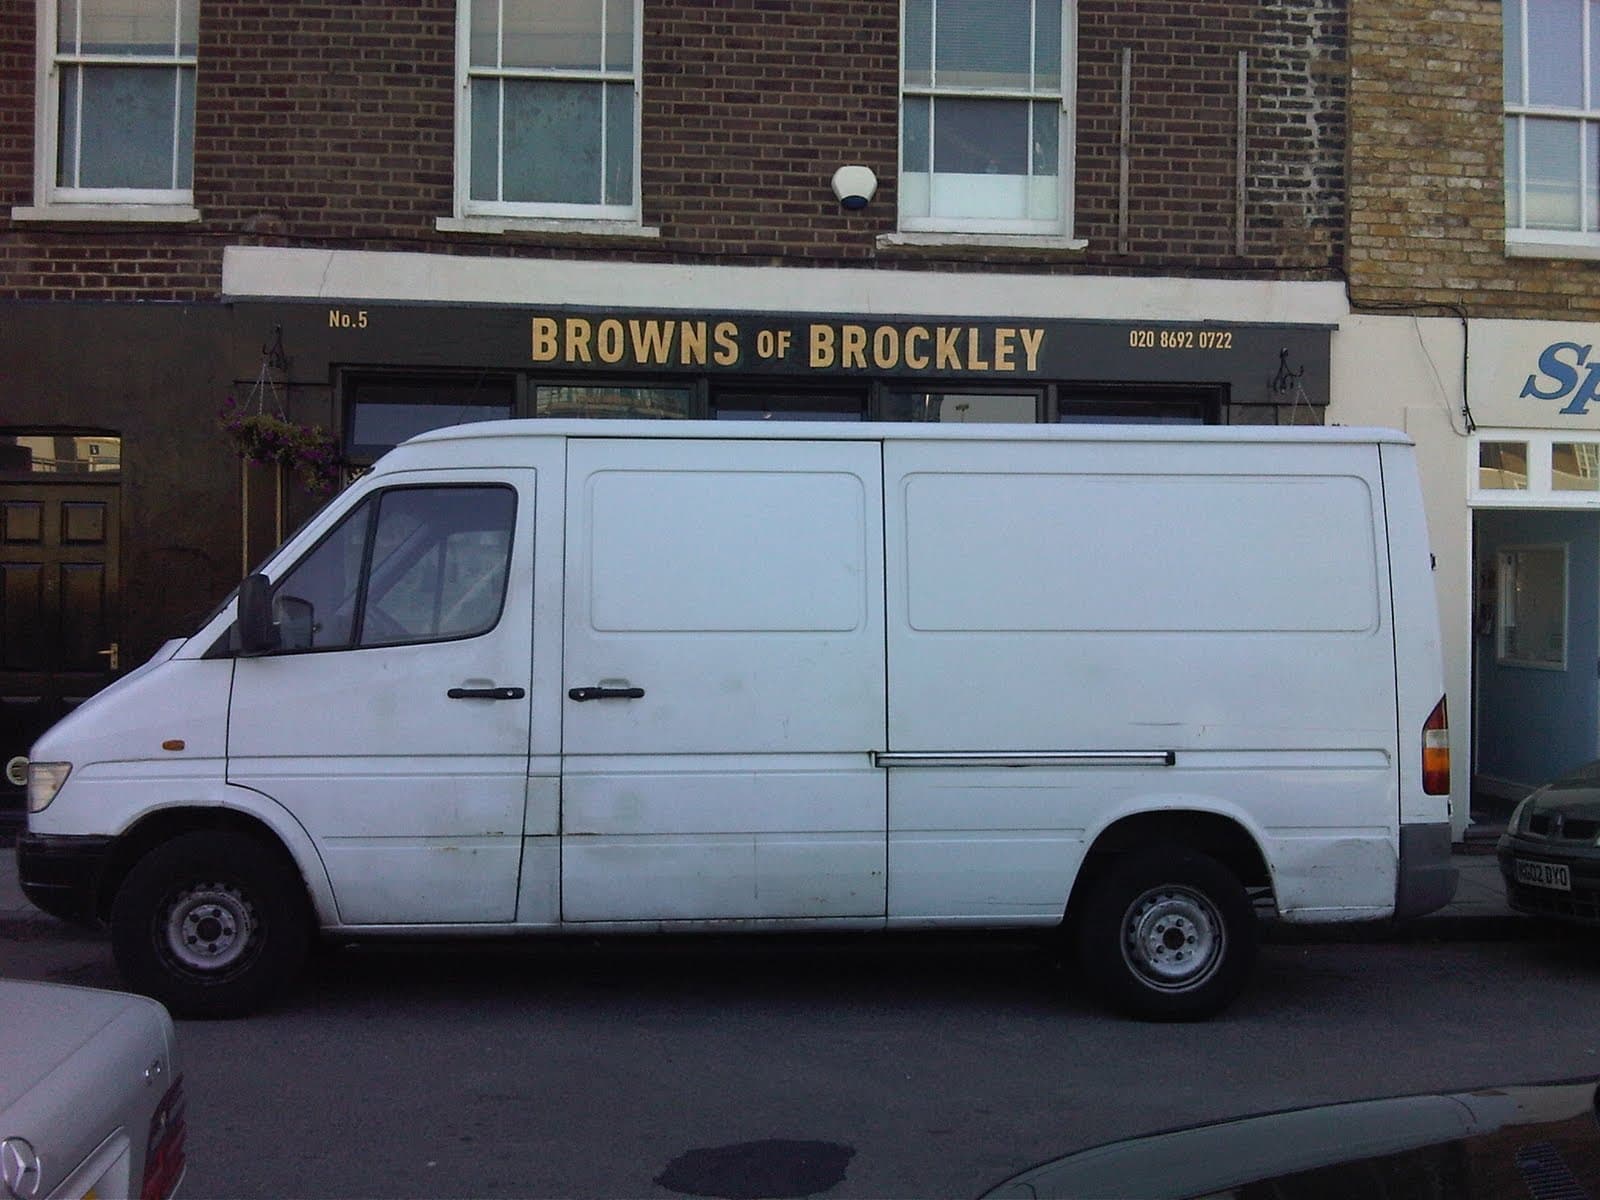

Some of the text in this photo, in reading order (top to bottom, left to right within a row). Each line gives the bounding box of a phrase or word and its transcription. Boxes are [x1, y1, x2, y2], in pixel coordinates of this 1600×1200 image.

[329, 309, 368, 328] No.5
[532, 317, 1045, 371] BROWNS OF BROCKLEY
[1129, 330, 1233, 349] 020 8692 0722
[1519, 341, 1600, 415] Sp
